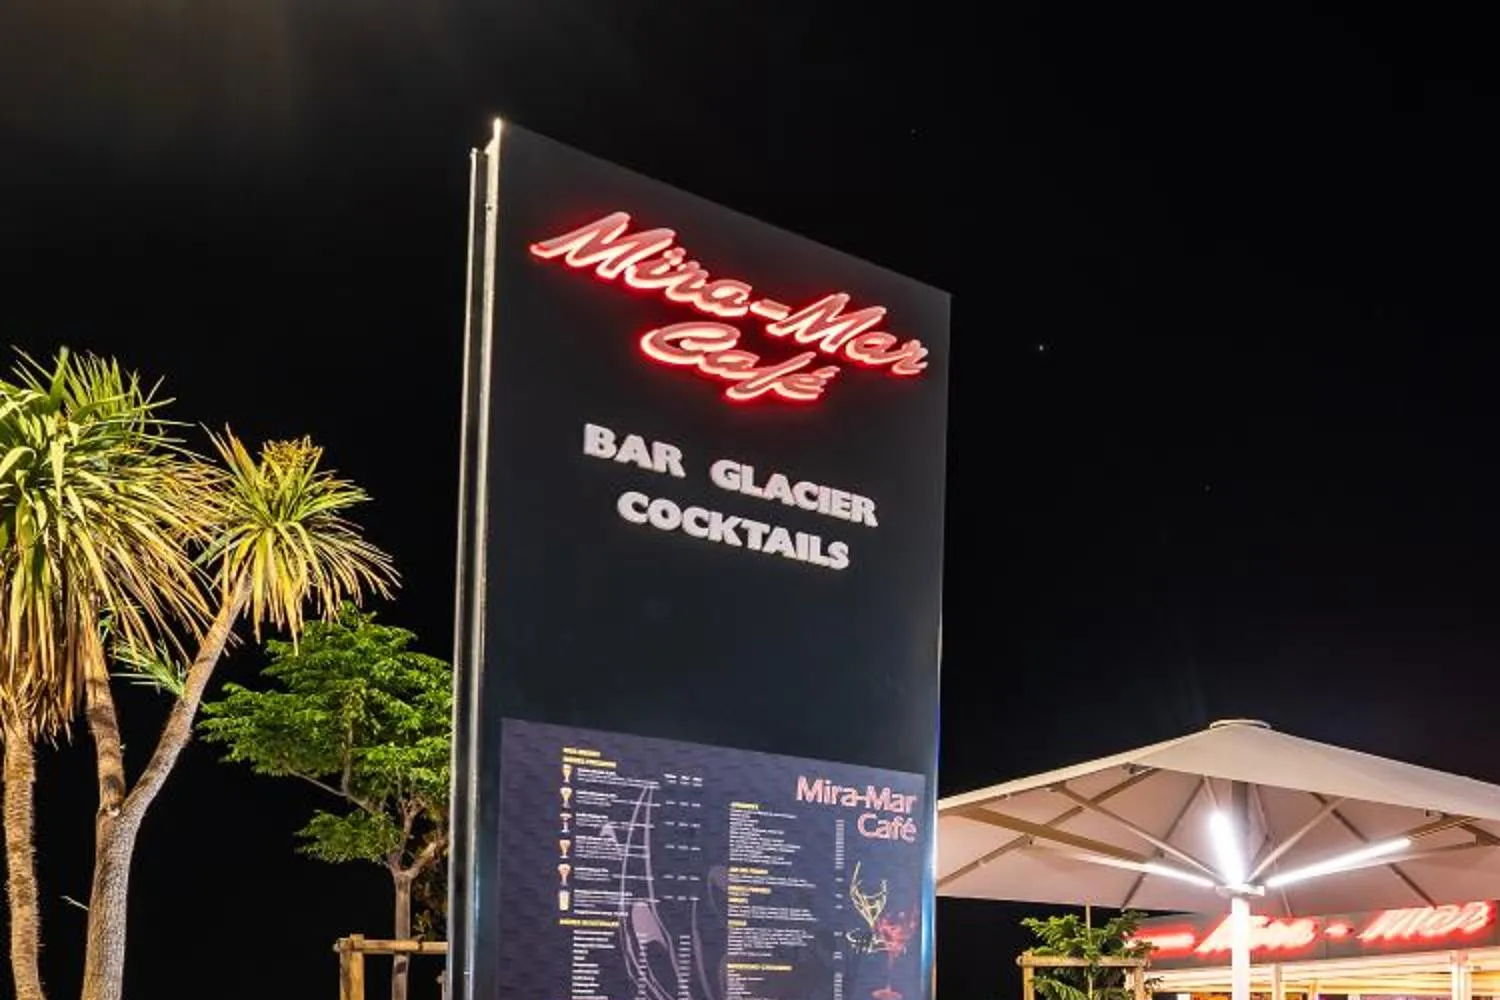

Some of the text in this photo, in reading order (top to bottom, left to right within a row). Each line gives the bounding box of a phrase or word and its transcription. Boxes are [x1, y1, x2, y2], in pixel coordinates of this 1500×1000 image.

[529, 210, 929, 376] Mira-Mar
[640, 320, 841, 401] Café
[583, 423, 879, 527] BAR GLACIER
[617, 491, 851, 570] COCKTAILS
[796, 775, 918, 814] Mira-Mar
[857, 811, 918, 843] Café
